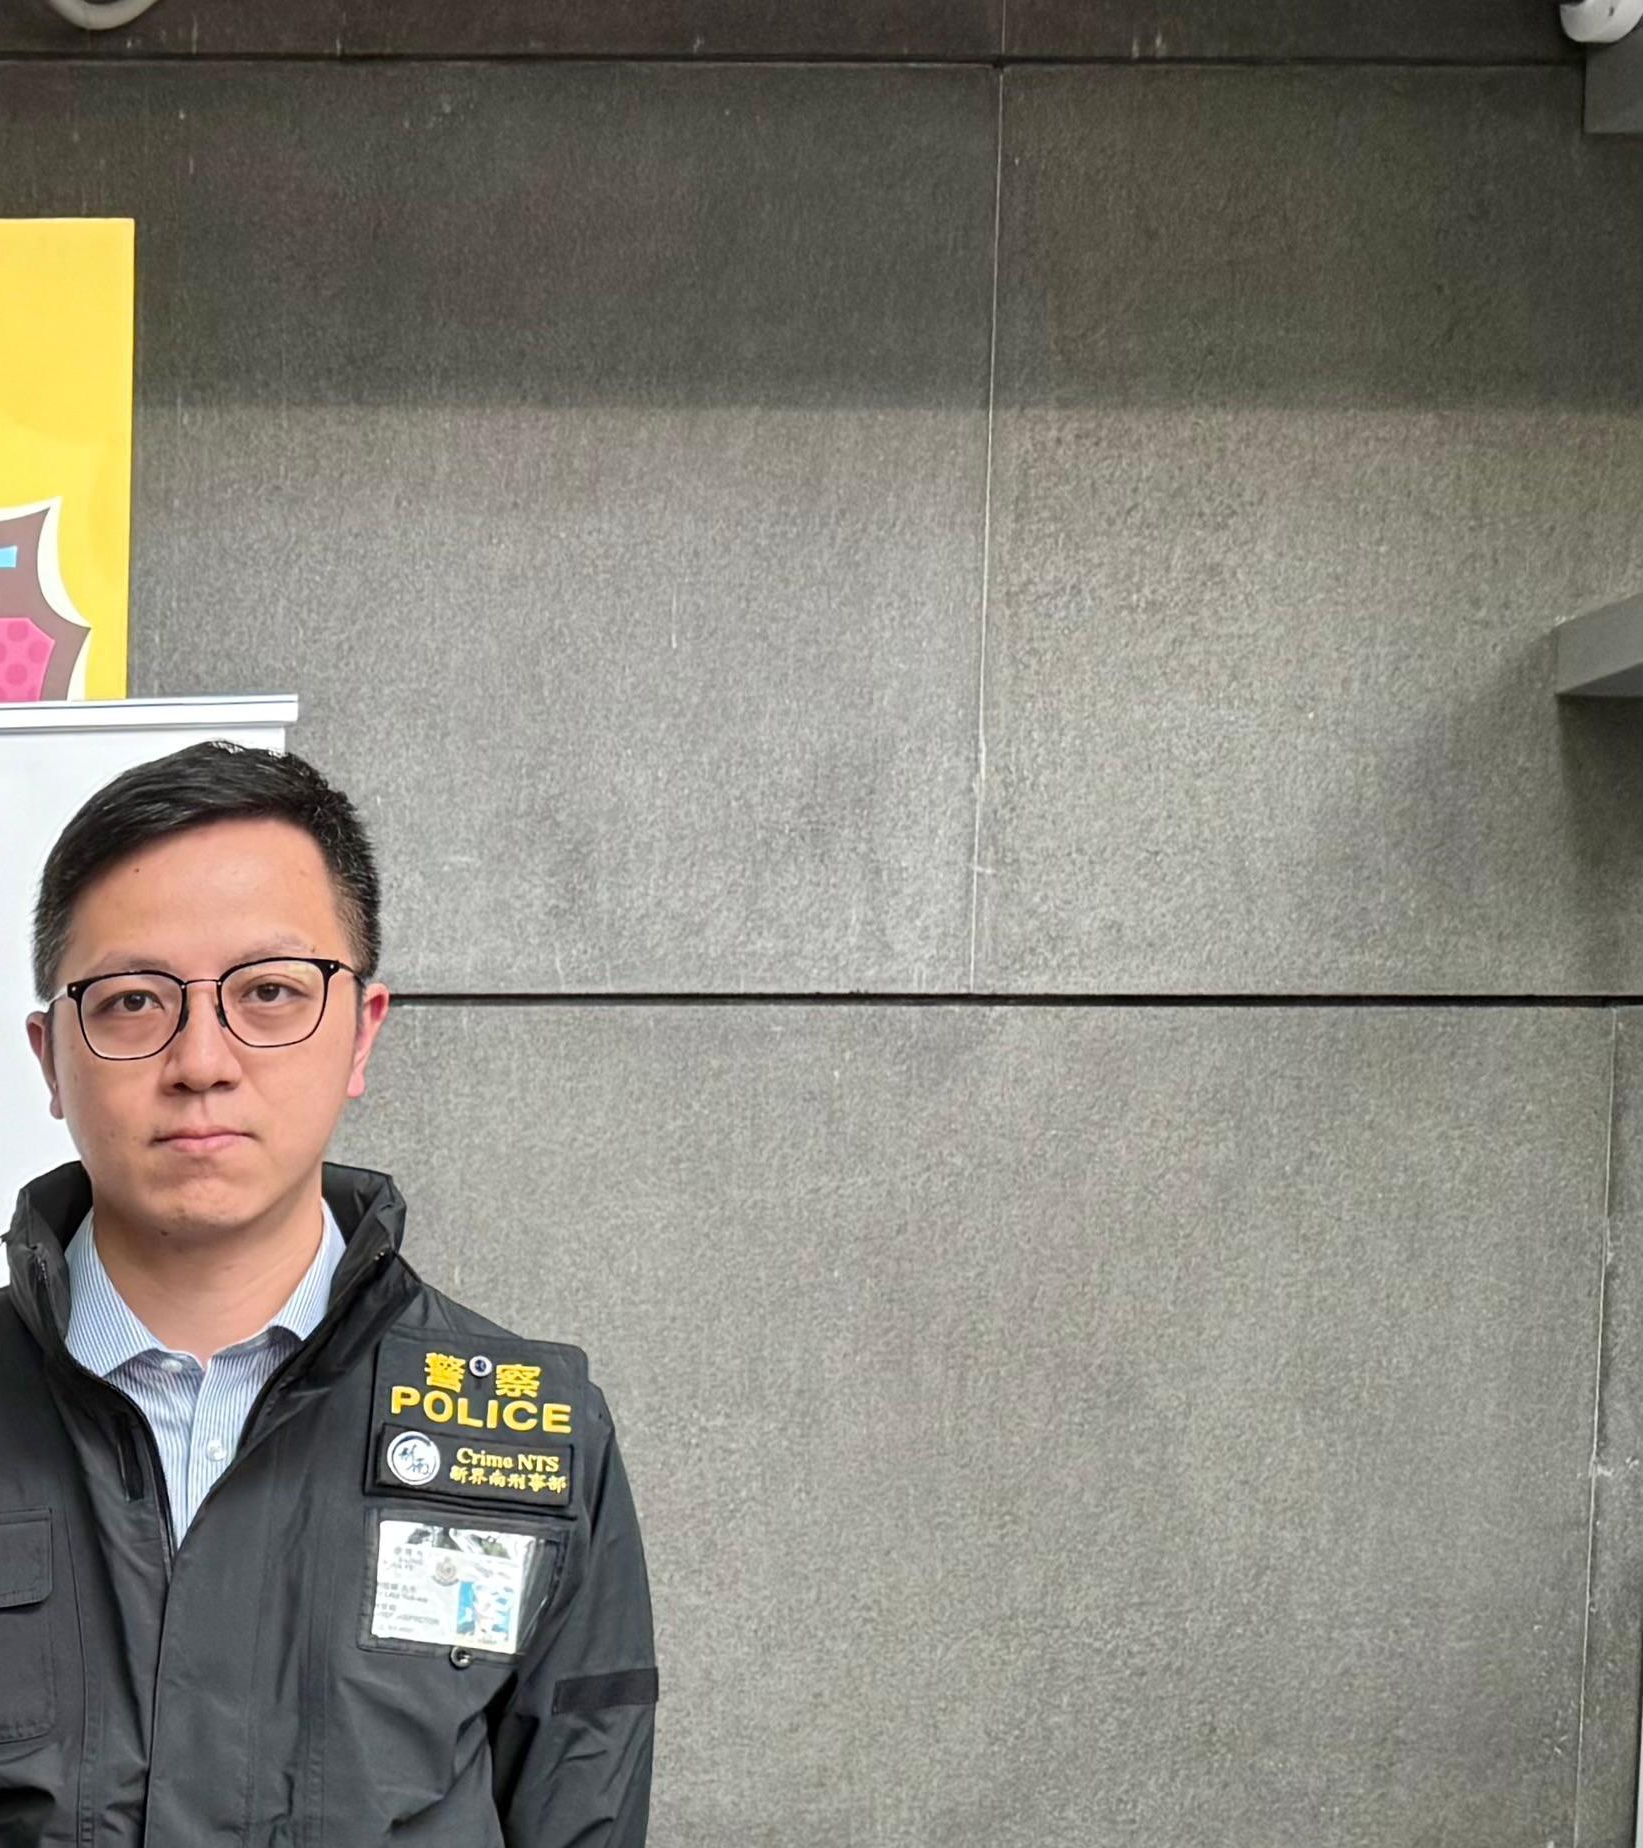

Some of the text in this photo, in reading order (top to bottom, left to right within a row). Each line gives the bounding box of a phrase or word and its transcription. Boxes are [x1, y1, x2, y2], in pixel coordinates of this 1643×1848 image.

[424, 1352, 541, 1398] 警察
[390, 1385, 571, 1433] POLICE
[456, 1447, 560, 1473] Crime NTS
